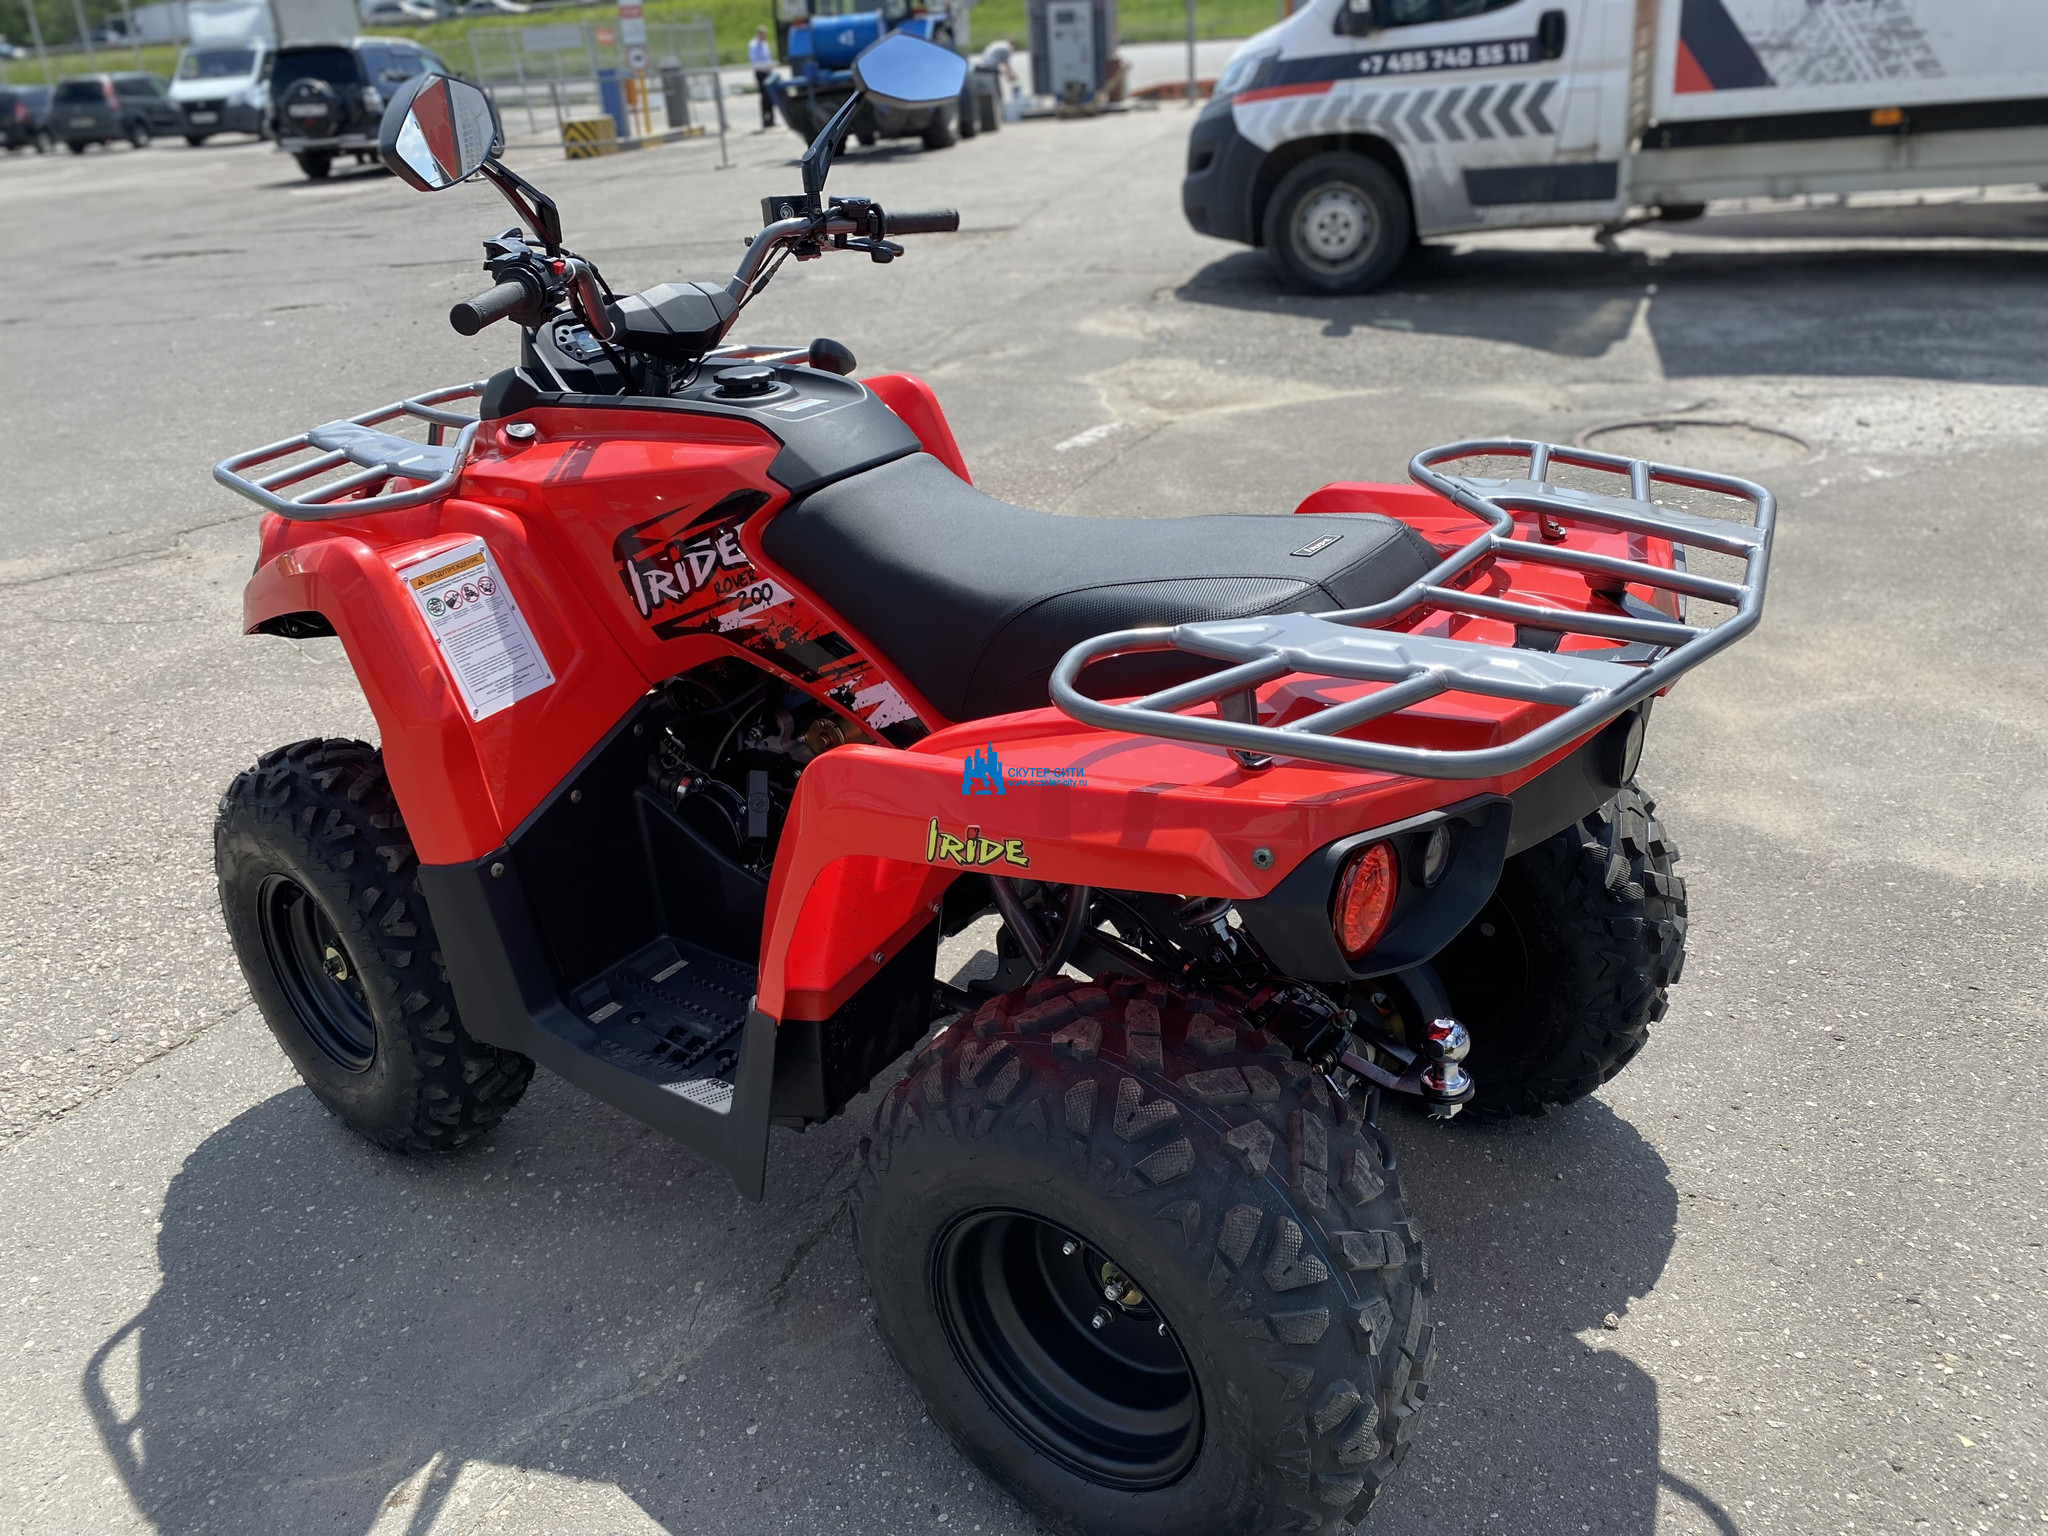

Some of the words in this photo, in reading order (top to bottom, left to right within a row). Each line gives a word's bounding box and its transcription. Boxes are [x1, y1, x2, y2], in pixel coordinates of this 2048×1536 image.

[1358, 55, 1384, 75] +7
[1431, 47, 1473, 69] 740
[1476, 44, 1504, 66] 55
[1508, 42, 1530, 62] 11
[426, 556, 479, 580] ПРЕДУПРЕЖДЕНИЕ
[714, 569, 758, 597] ROVER
[737, 583, 773, 612] 200
